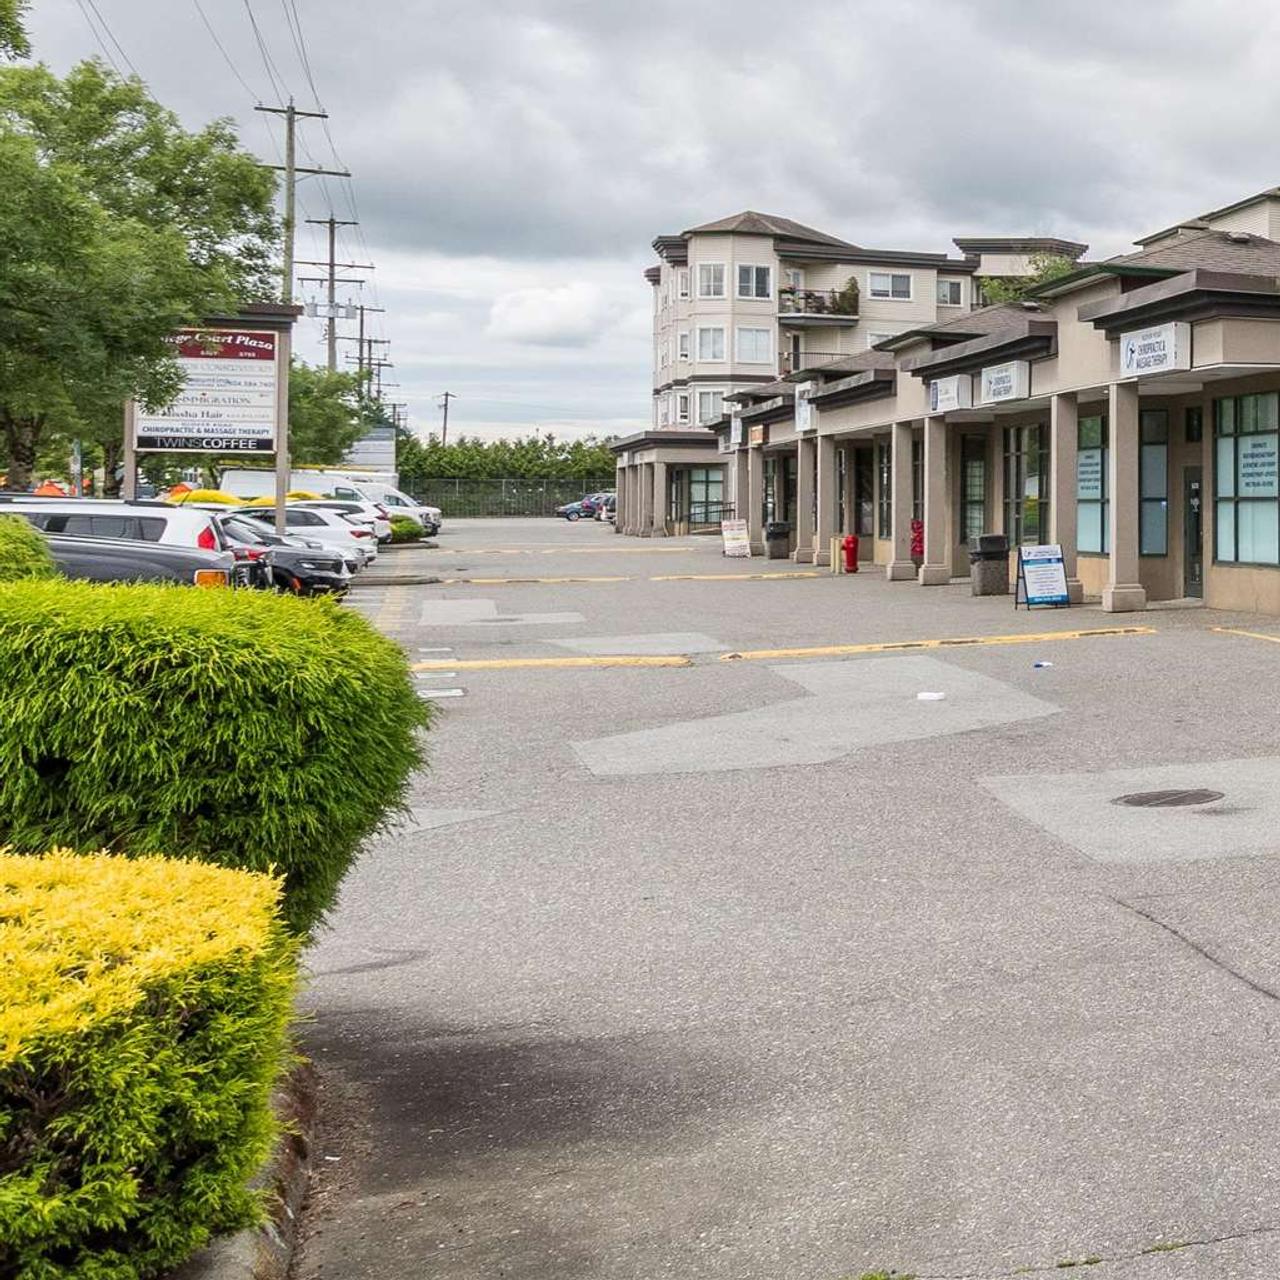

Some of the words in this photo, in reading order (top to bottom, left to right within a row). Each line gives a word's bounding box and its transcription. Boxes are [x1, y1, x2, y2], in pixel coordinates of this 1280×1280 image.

[235, 335, 273, 350] Plaza
[142, 426, 194, 435] CHIROPRACTIC
[203, 427, 237, 435] MASSAGE
[238, 427, 270, 436] THERAPY
